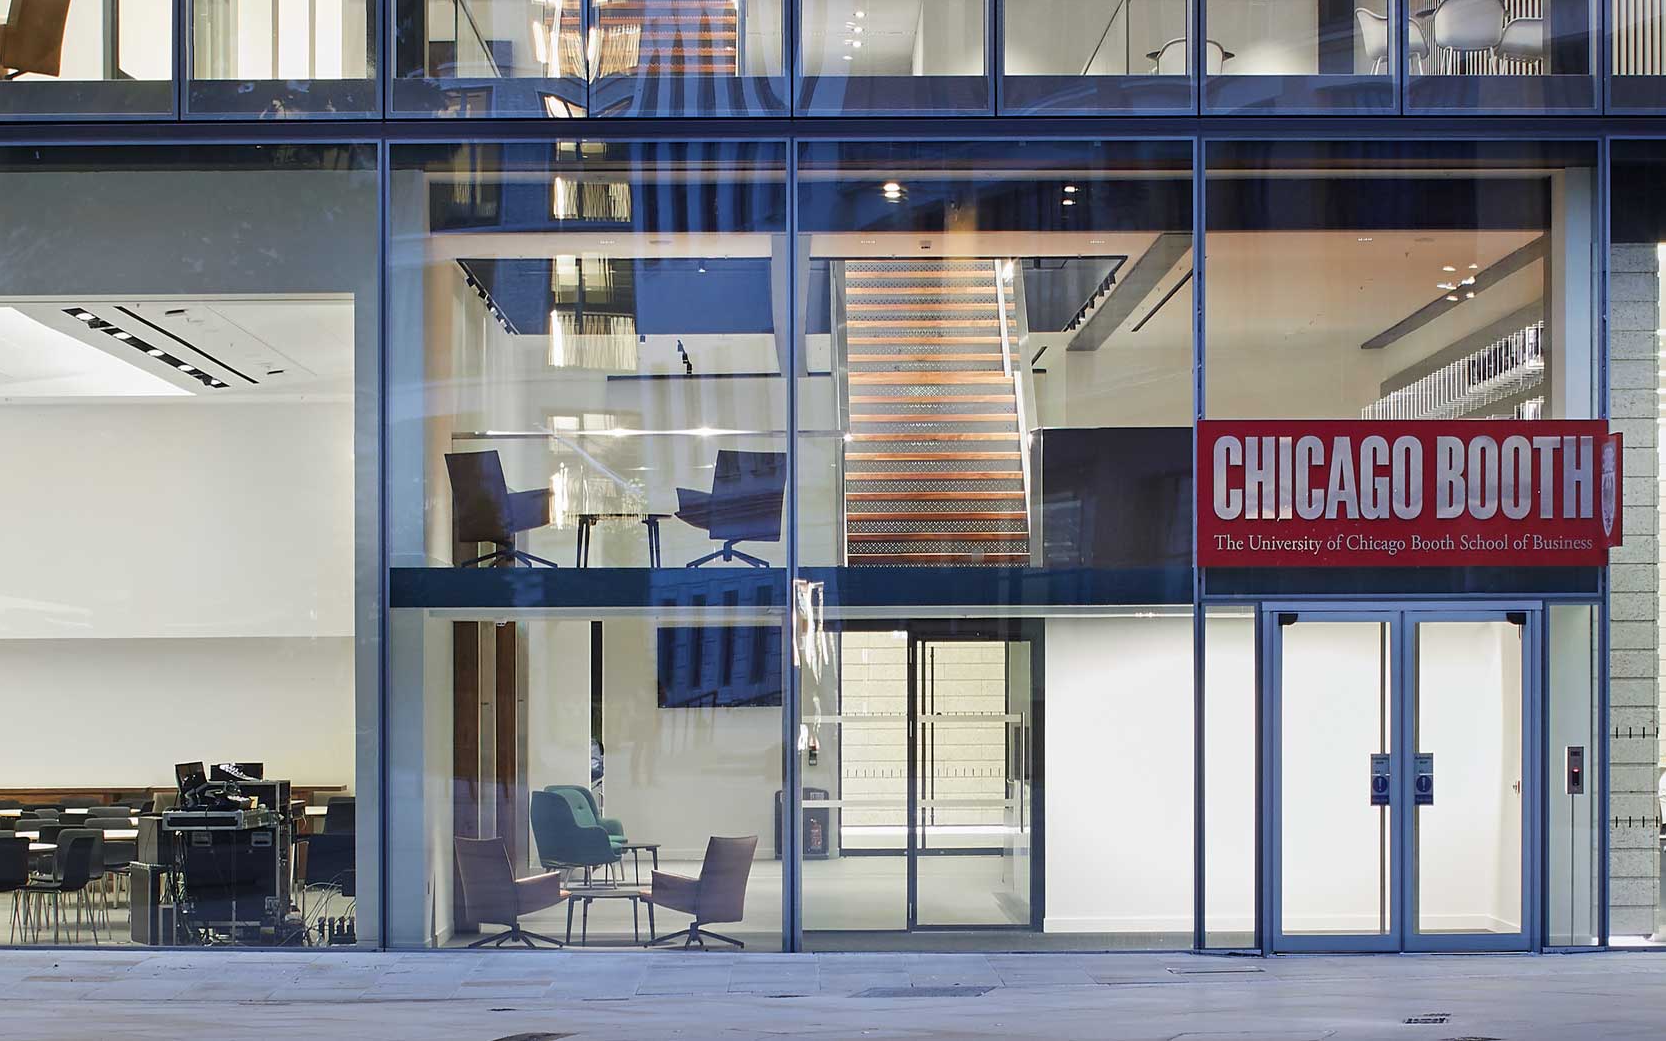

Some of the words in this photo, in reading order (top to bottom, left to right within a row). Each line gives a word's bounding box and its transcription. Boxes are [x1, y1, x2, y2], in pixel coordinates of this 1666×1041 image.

[1213, 435, 1423, 520] CHICAGO
[1436, 435, 1594, 520] BOOTH
[1213, 534, 1244, 550] The
[1248, 534, 1323, 555] University
[1327, 534, 1344, 550] of
[1346, 534, 1406, 555] Chicago
[1411, 534, 1455, 550] Booth
[1460, 534, 1509, 550] School
[1513, 534, 1529, 550] of
[1533, 534, 1593, 550] Business
